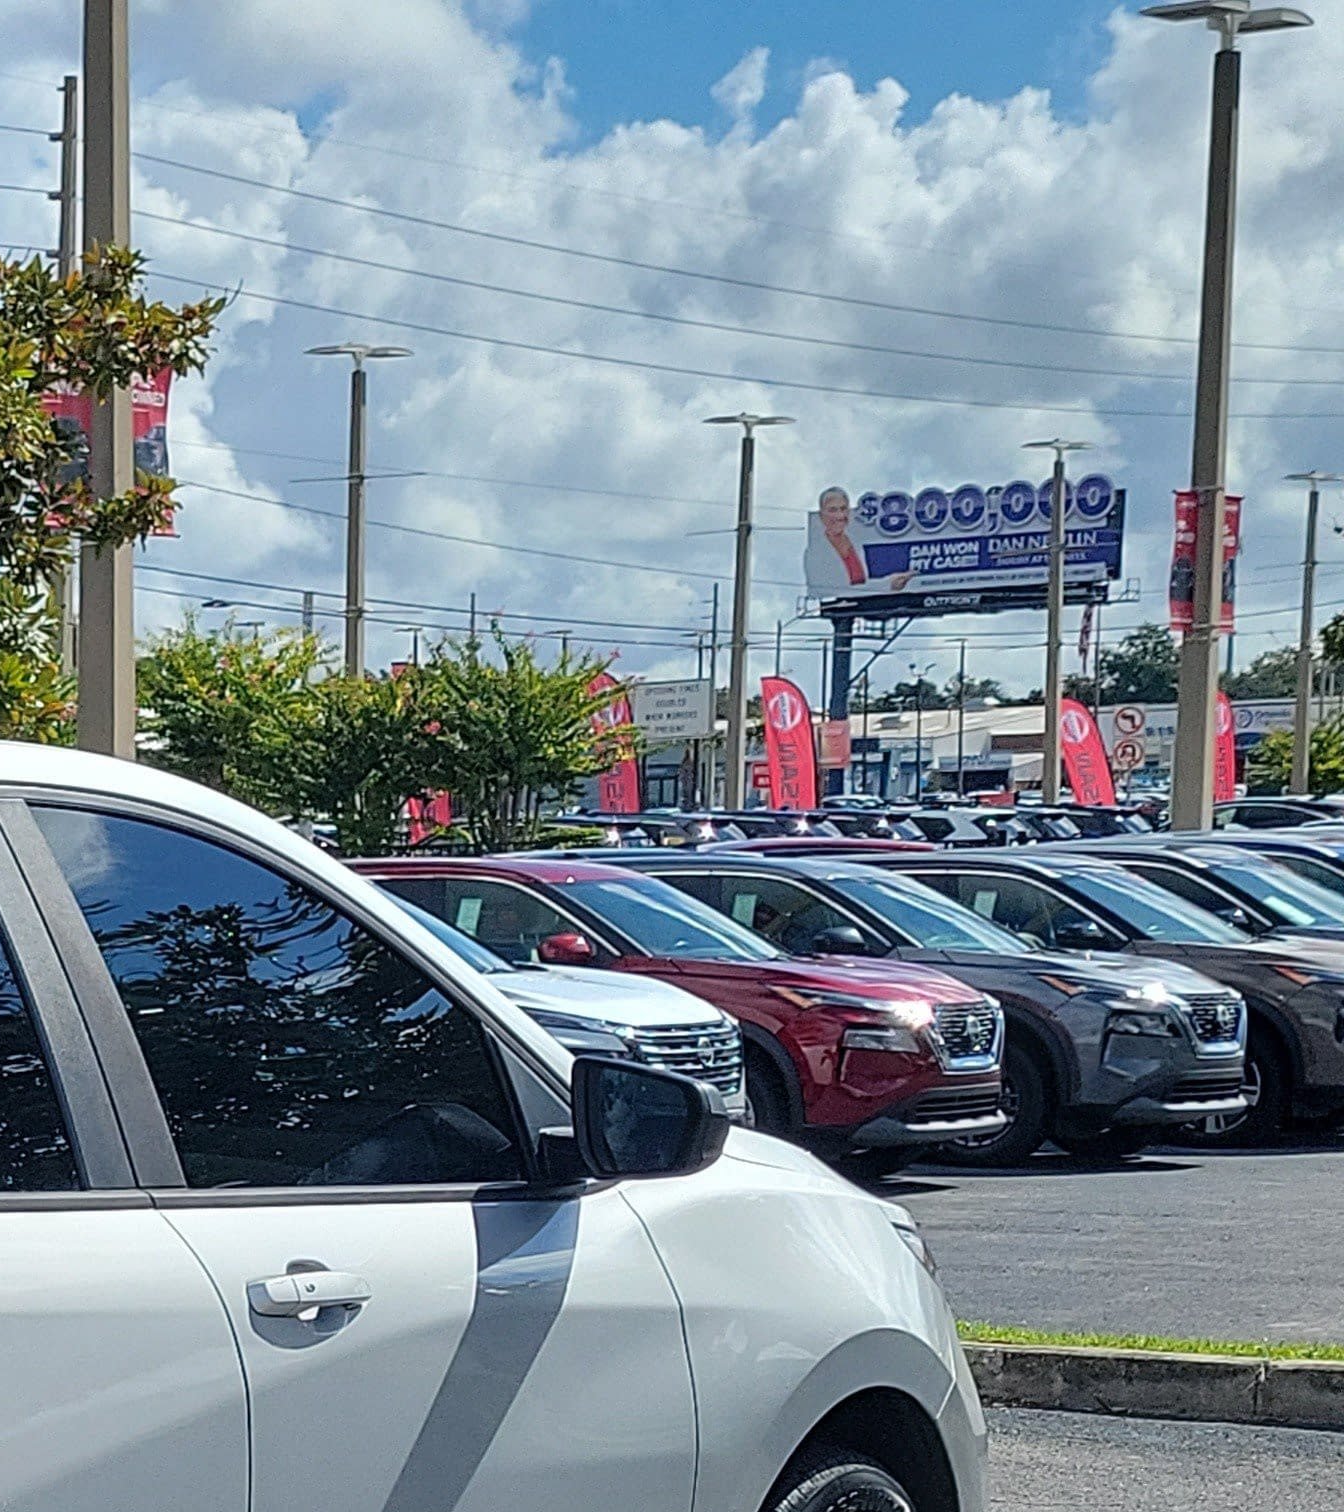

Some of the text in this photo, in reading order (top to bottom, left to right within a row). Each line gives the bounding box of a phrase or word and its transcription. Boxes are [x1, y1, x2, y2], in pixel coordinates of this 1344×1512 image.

[858, 474, 1113, 536] $800,000
[910, 541, 979, 558] DAN WON
[989, 531, 1097, 553] DAN NELIN
